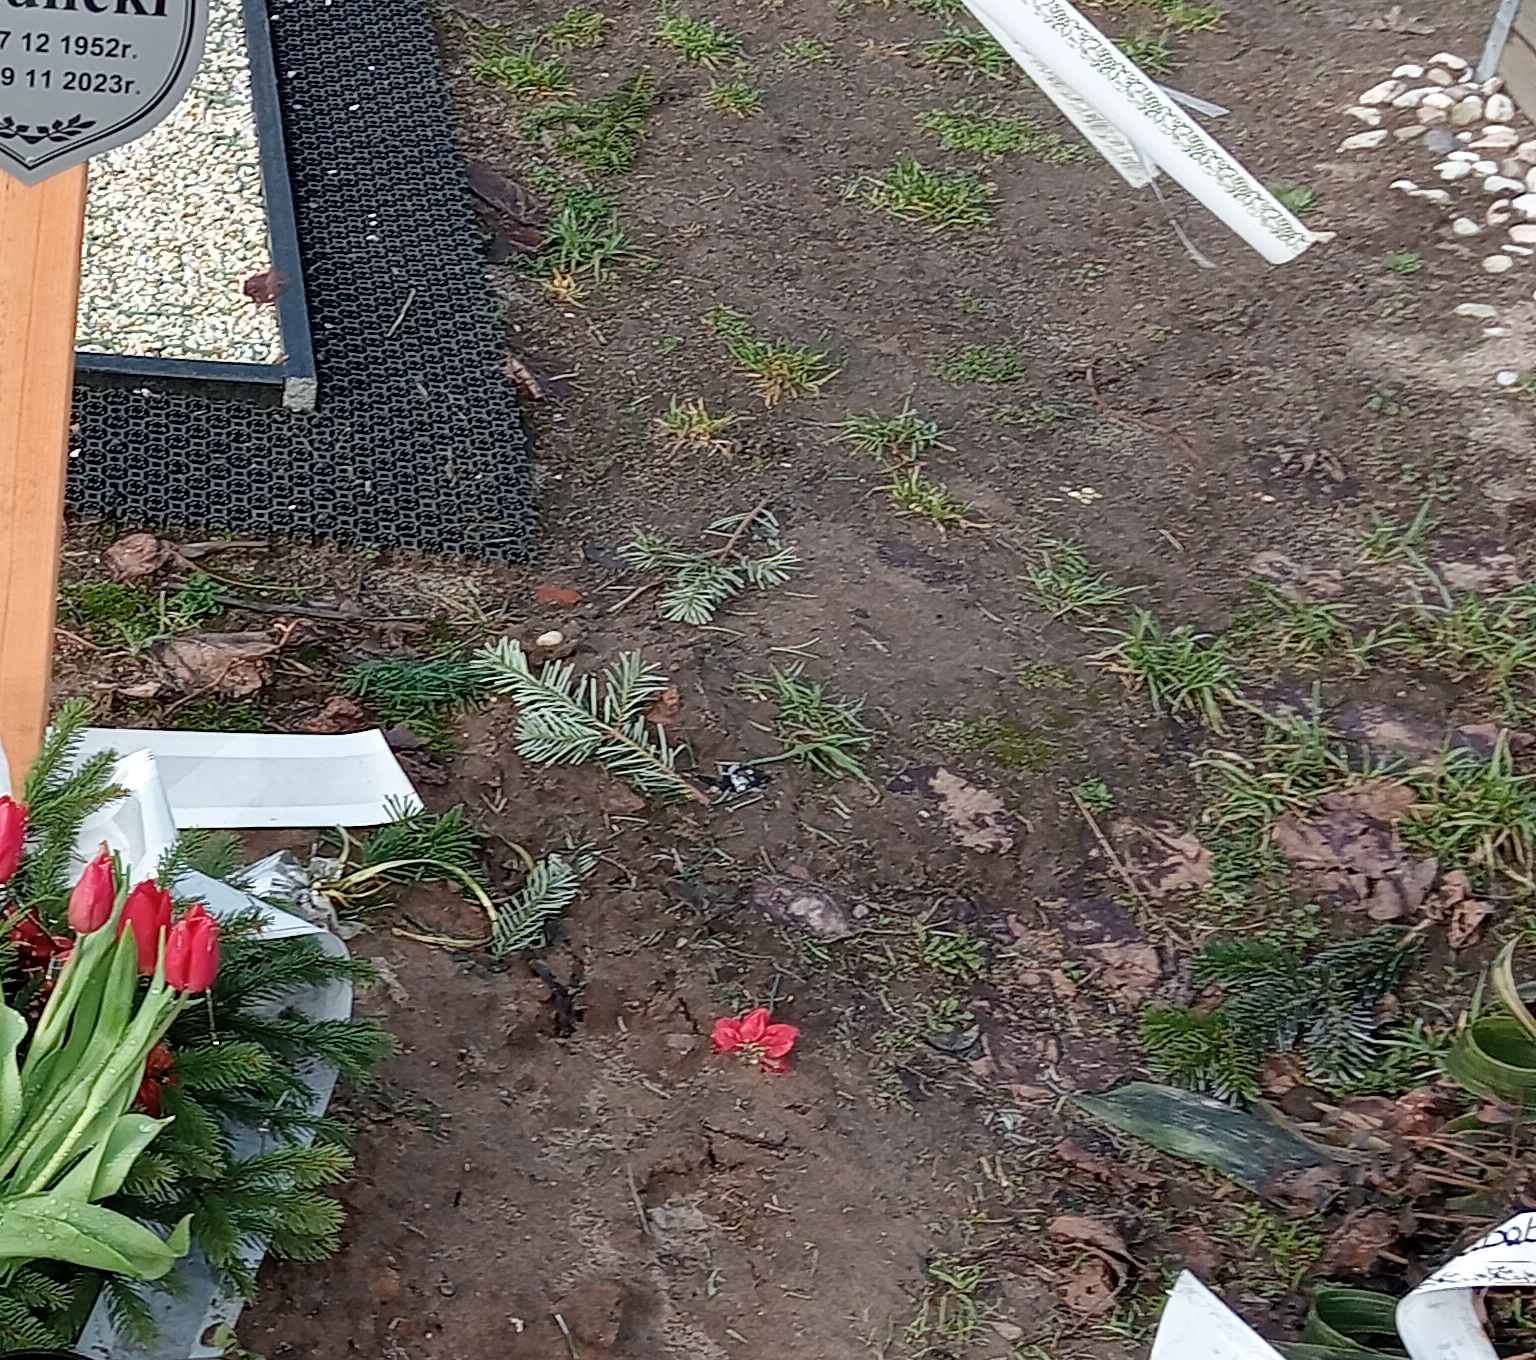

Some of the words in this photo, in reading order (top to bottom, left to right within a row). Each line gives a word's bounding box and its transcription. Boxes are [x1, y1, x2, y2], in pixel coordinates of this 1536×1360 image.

[19, 32, 50, 54] 12
[58, 35, 138, 60] 1952r.
[25, 69, 52, 90] 11
[63, 71, 142, 96] 2023r.
